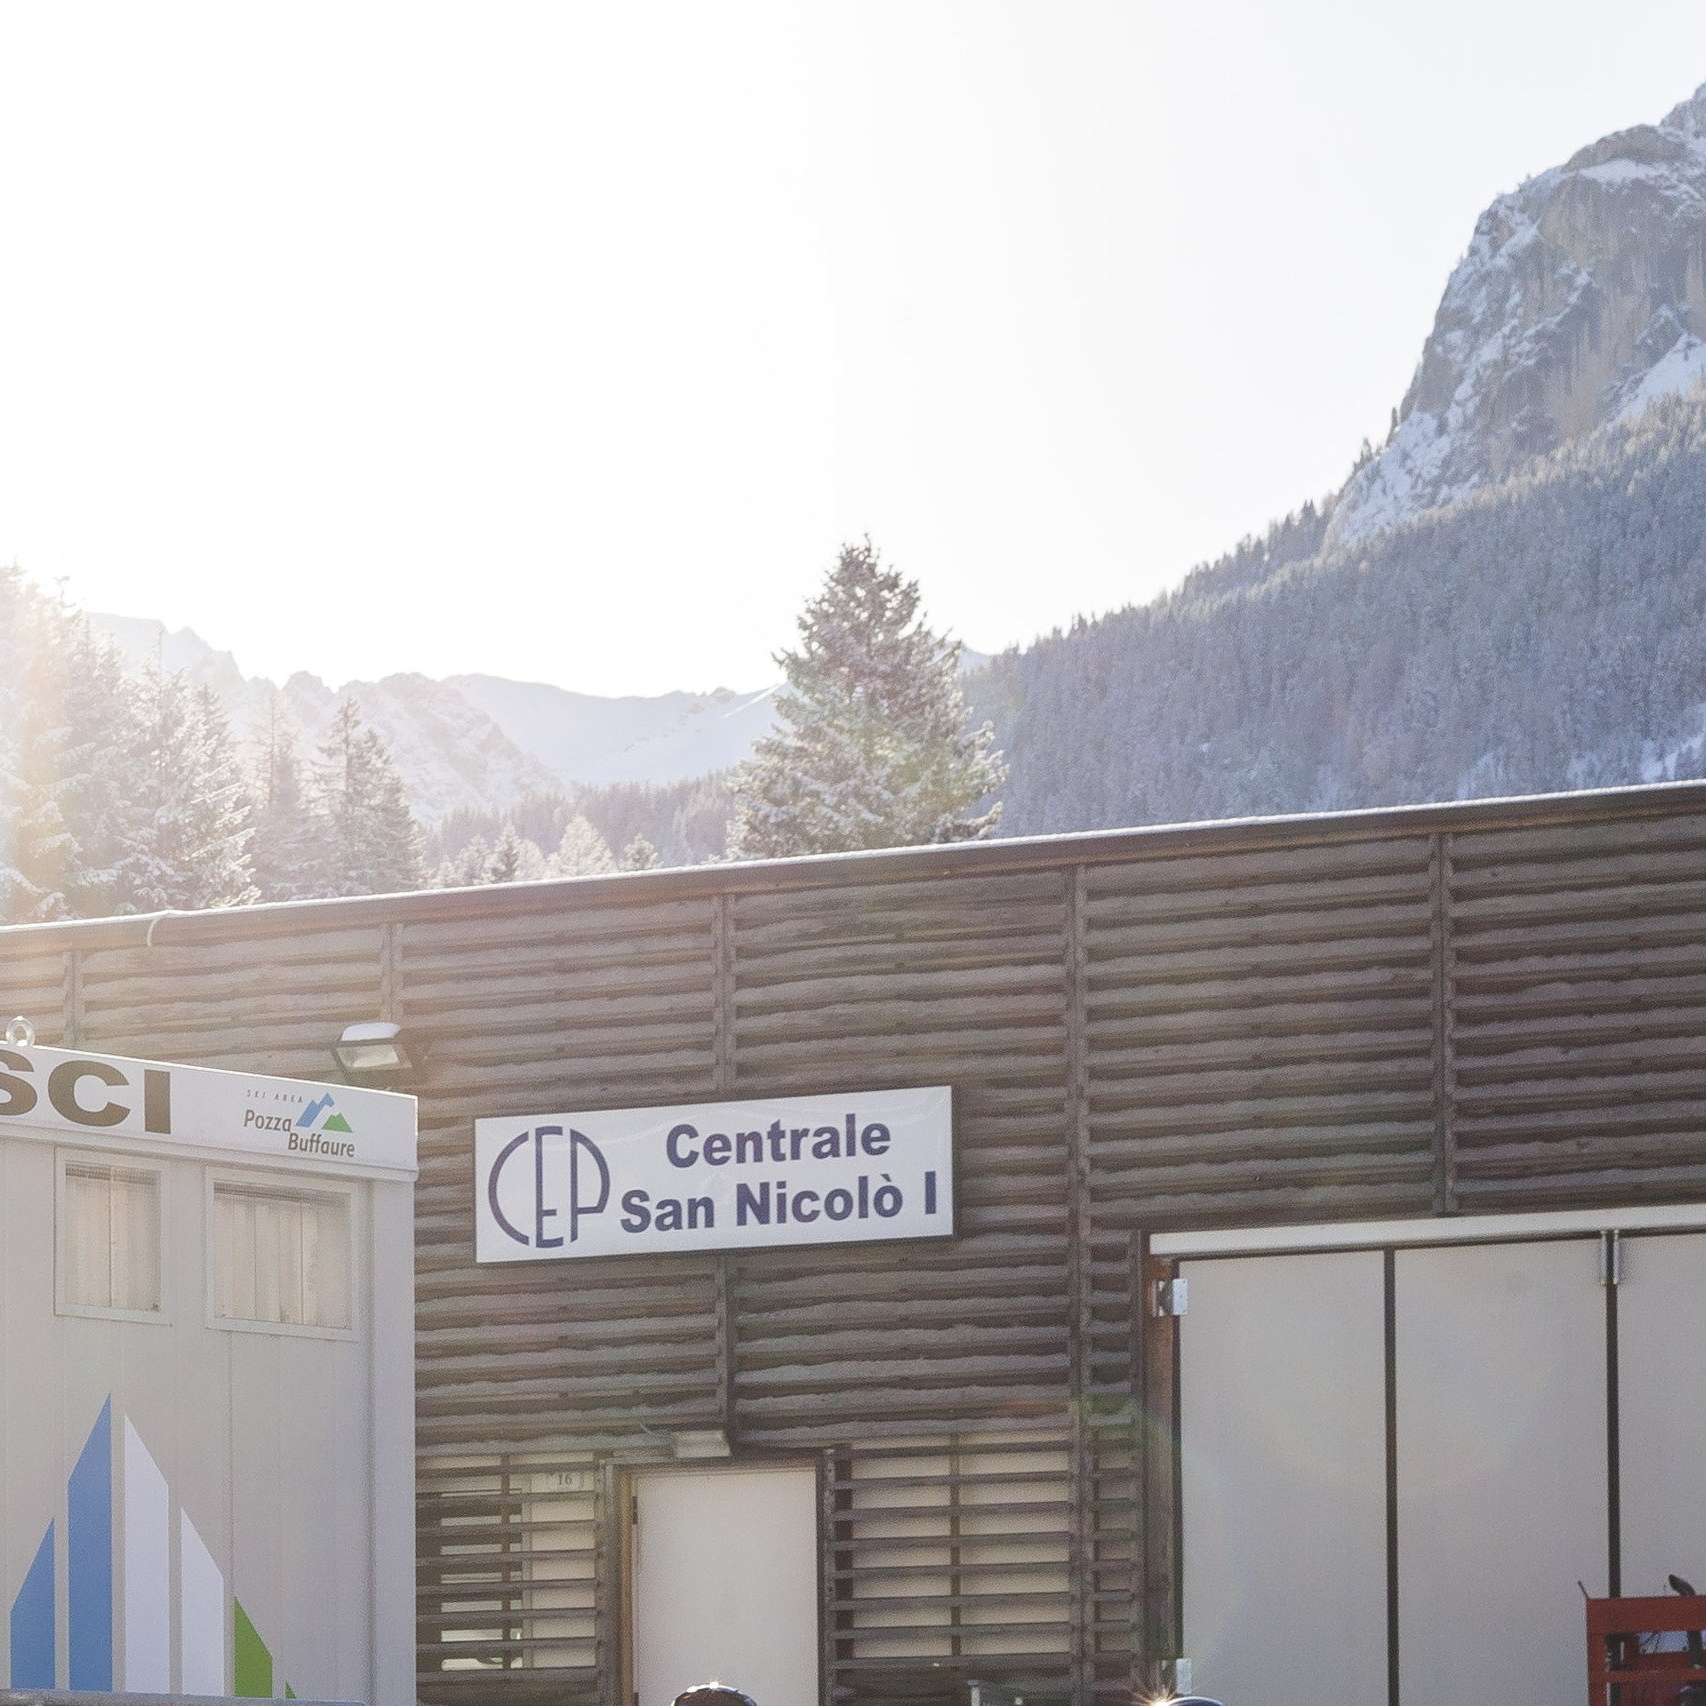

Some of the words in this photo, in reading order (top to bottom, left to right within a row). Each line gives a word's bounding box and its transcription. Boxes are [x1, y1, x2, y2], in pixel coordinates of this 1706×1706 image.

[246, 1089, 266, 1100] SKI
[243, 1109, 293, 1132] Pozza
[288, 1132, 356, 1158] Buffaure
[666, 1113, 891, 1169] Centrale
[620, 1189, 715, 1234] San
[736, 1173, 904, 1226] Nicolò
